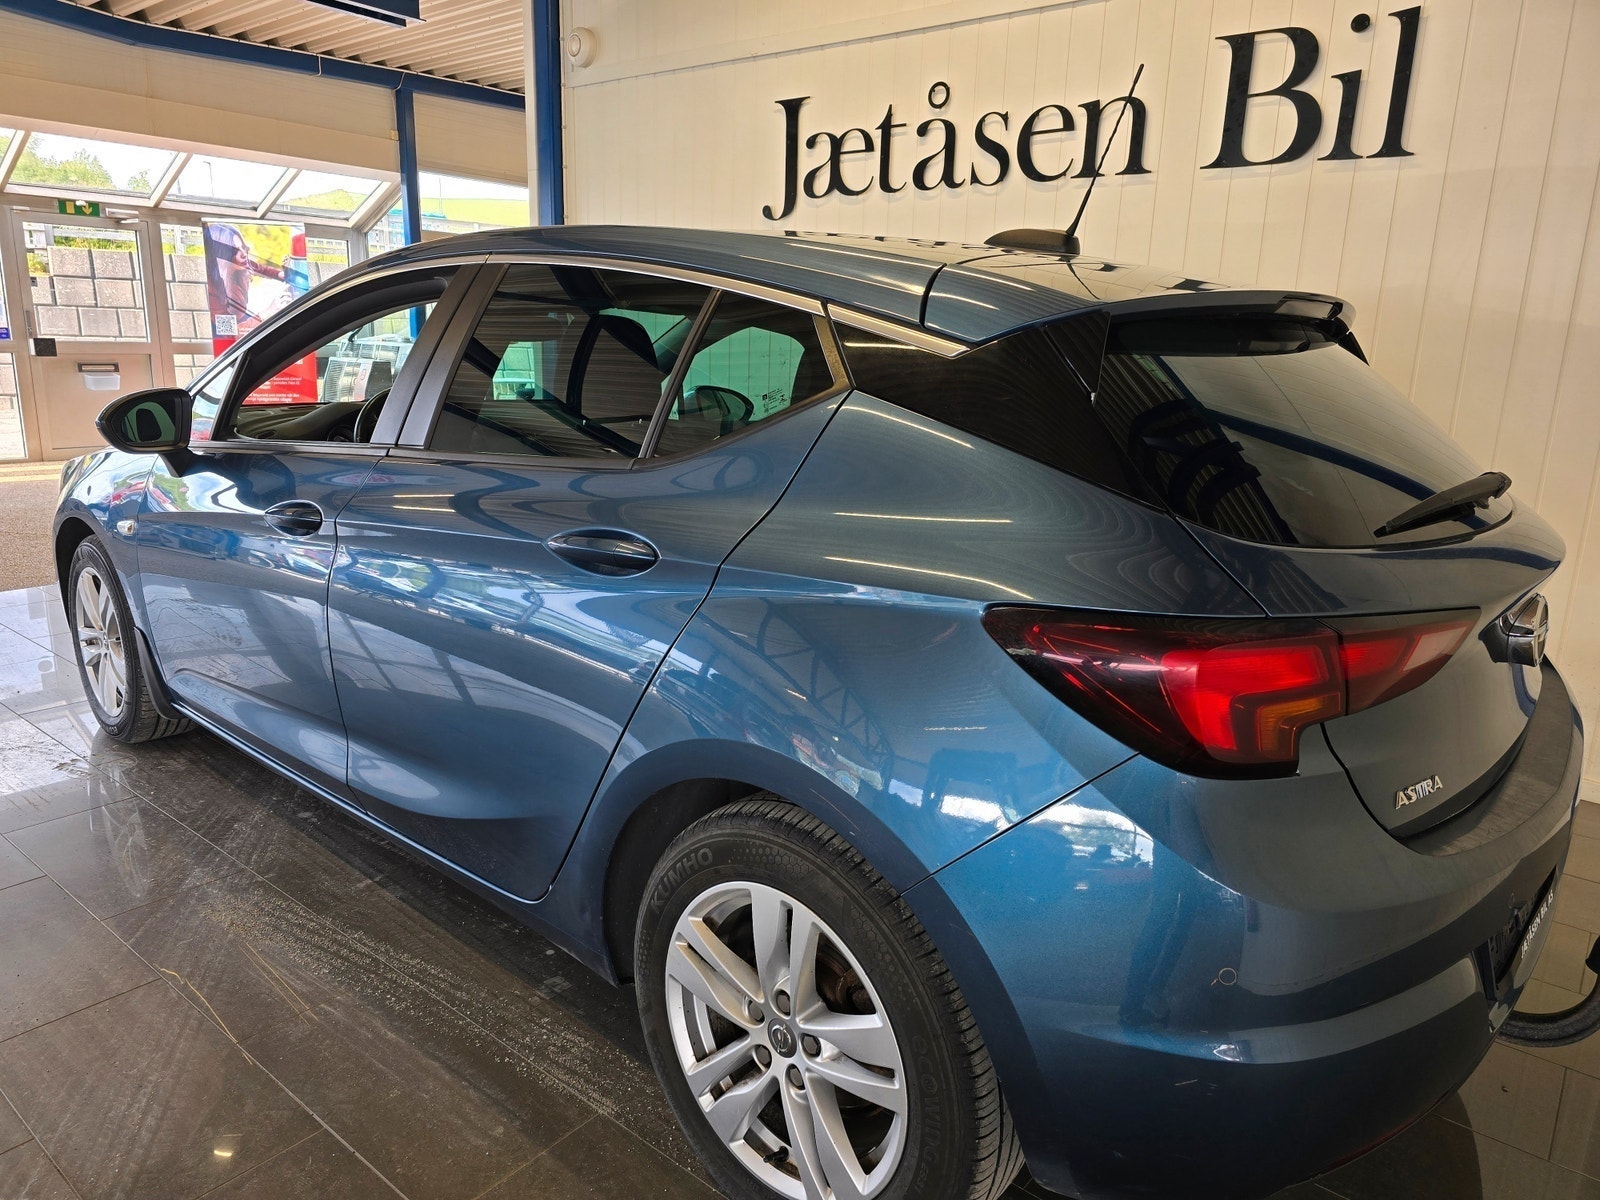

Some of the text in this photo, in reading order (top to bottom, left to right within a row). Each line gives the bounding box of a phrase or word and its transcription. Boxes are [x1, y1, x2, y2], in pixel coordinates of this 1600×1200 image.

[762, 5, 1422, 221] Jætåsen Bil
[1394, 774, 1443, 810] ASTRA
[650, 847, 713, 914] KUMHO
